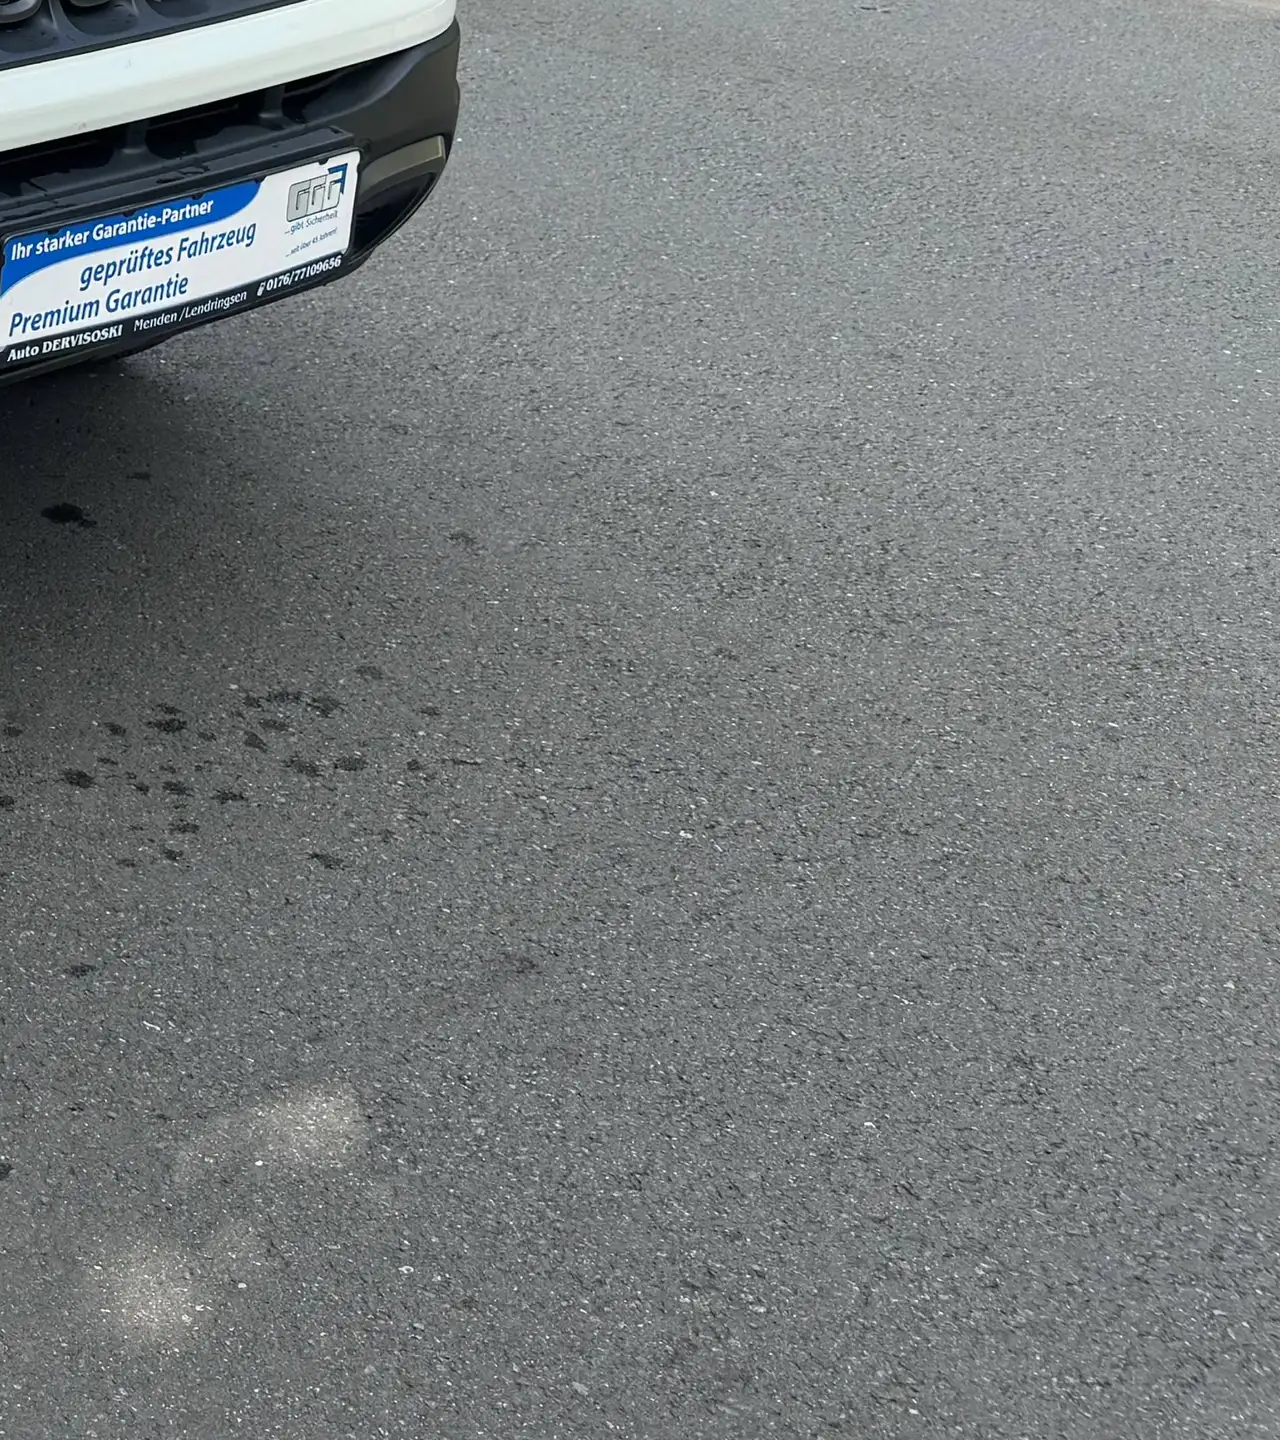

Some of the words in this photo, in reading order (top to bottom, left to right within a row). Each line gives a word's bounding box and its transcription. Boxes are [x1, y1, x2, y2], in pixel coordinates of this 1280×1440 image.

[11, 241, 33, 261] Ihr
[36, 229, 89, 254] starker
[93, 199, 214, 241] Garantie-Partner
[300, 239, 311, 250] über
[306, 210, 338, 228] Sicherheit
[80, 244, 173, 292] geprüftes
[177, 222, 257, 262] Fahrzeug
[7, 345, 40, 362] Auto
[42, 325, 124, 354] DERVISOSKI
[267, 255, 342, 291] 0176/77109656
[9, 300, 99, 337] Premium
[105, 274, 188, 314] Garantie
